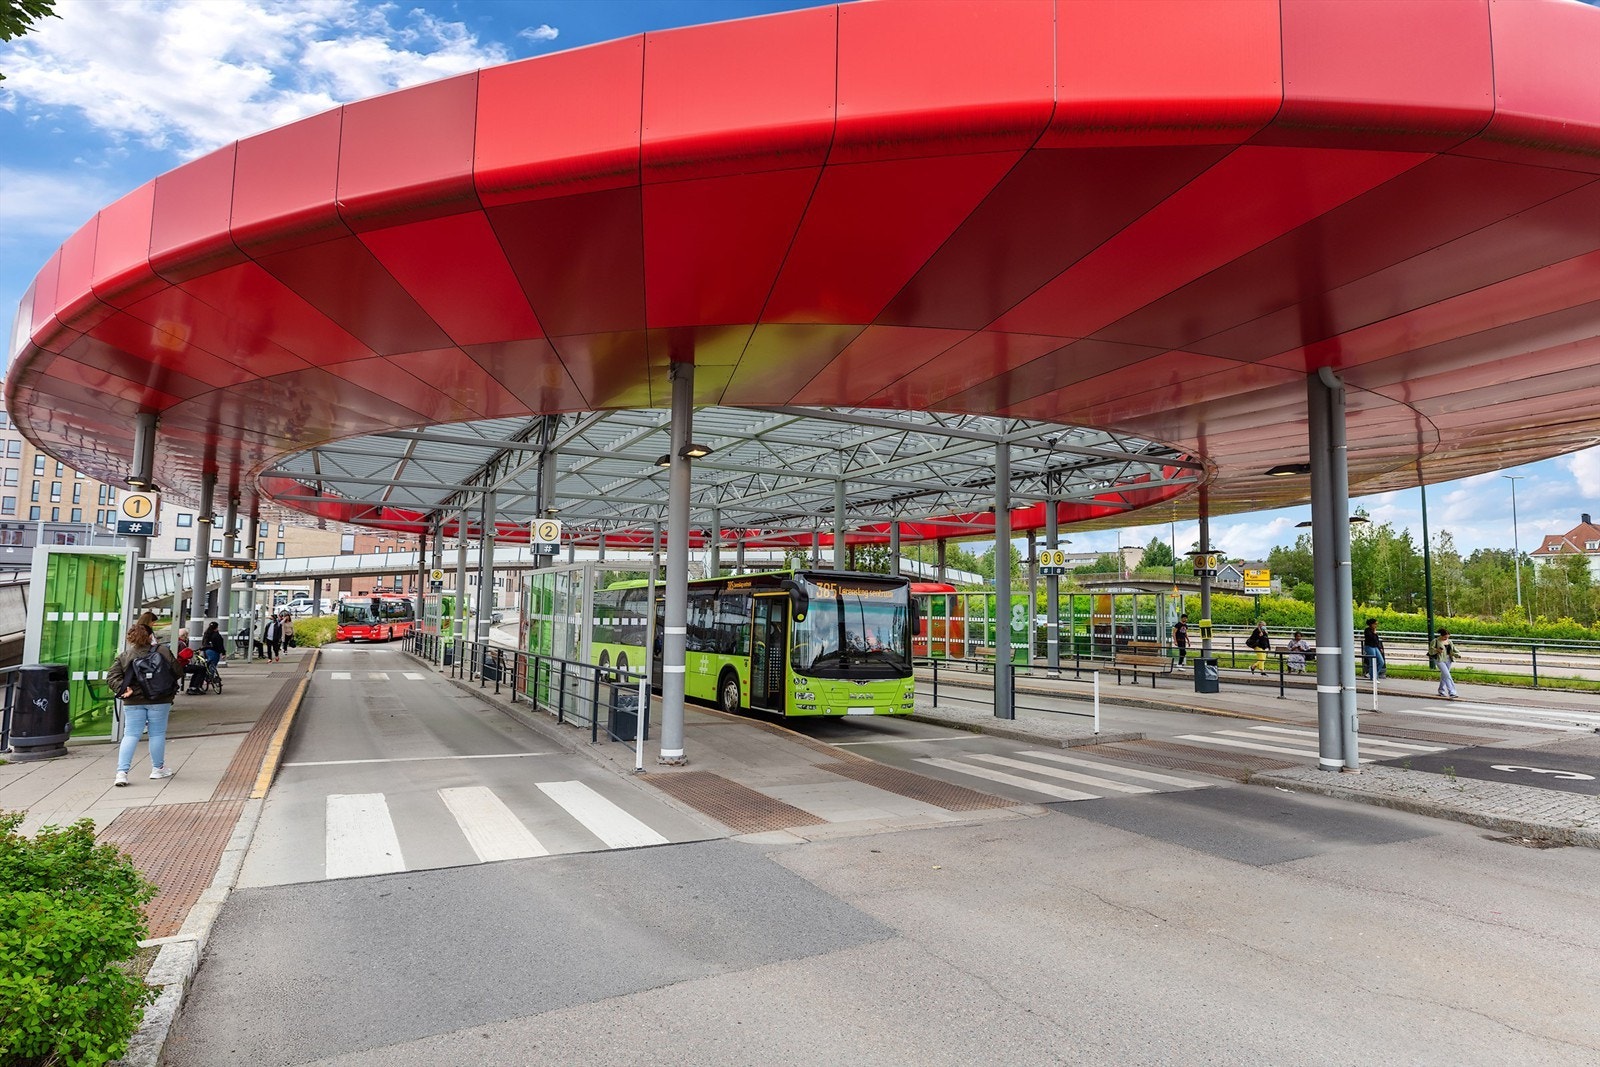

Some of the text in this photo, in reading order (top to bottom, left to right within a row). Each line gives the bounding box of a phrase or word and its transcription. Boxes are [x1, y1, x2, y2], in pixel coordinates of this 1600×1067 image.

[133, 500, 141, 513] 1
[545, 526, 553, 537] 2
[1043, 554, 1048, 562] 3
[1057, 554, 1062, 562] 3
[816, 582, 838, 598] 385
